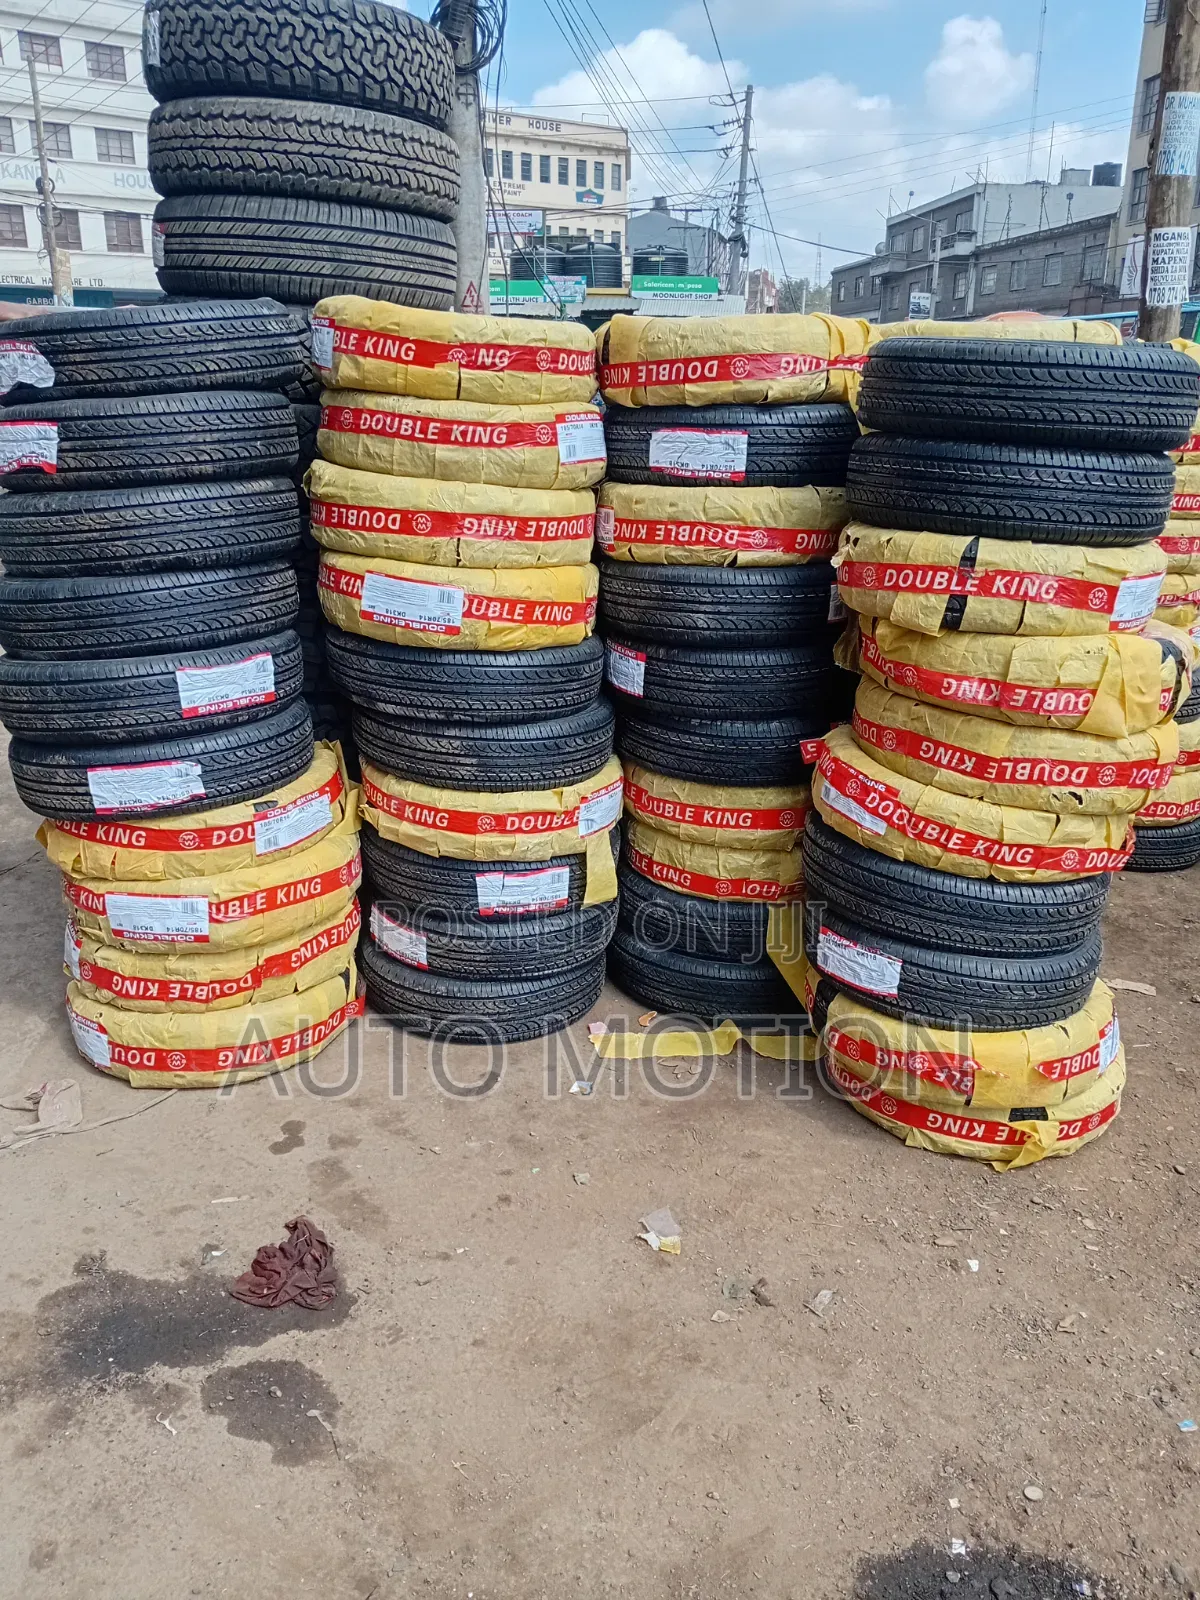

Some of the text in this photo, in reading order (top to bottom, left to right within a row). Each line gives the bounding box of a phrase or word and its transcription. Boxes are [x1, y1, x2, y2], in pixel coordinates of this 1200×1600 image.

[481, 112, 562, 132] IVER HOUSE
[503, 188, 522, 197] PAINT
[0, 274, 35, 285] ECTRICAL
[89, 278, 106, 287] LTD.
[333, 330, 417, 361] BLE KING
[557, 352, 596, 372] DOUBLE
[604, 360, 719, 385] DOUBLE KING
[359, 412, 441, 440] DOUBLE
[449, 423, 508, 445] KING
[1171, 496, 1199, 508] KING
[331, 509, 401, 531] DOUBLE
[462, 518, 585, 538] DOUBLE KING
[655, 524, 740, 545] DOUBLE
[795, 532, 837, 550] KING
[339, 569, 363, 594] KIN
[883, 568, 980, 592] DOUBLE
[991, 575, 1059, 600] KING
[373, 613, 446, 633] DOUBLEKING
[385, 608, 407, 618] DK318
[532, 603, 573, 622] KING
[941, 677, 1094, 713] OUBLE KING
[919, 740, 1088, 784] DOUBLE KING
[403, 804, 450, 828] KING
[505, 808, 580, 832] DOUBLE
[702, 809, 753, 827] KING
[96, 827, 147, 847] KING
[211, 826, 256, 847] DOU
[972, 838, 1035, 866] KING
[652, 863, 692, 887] KING
[79, 889, 105, 912] KIN
[211, 877, 322, 918] UBLE KING
[122, 931, 195, 942] DOUBLEKING
[290, 932, 331, 968] KING
[111, 973, 253, 1000] DOUBLE KING
[217, 1013, 342, 1067] DOUBLE KING
[109, 1046, 155, 1066] DOU
[927, 1112, 986, 1138] KING
